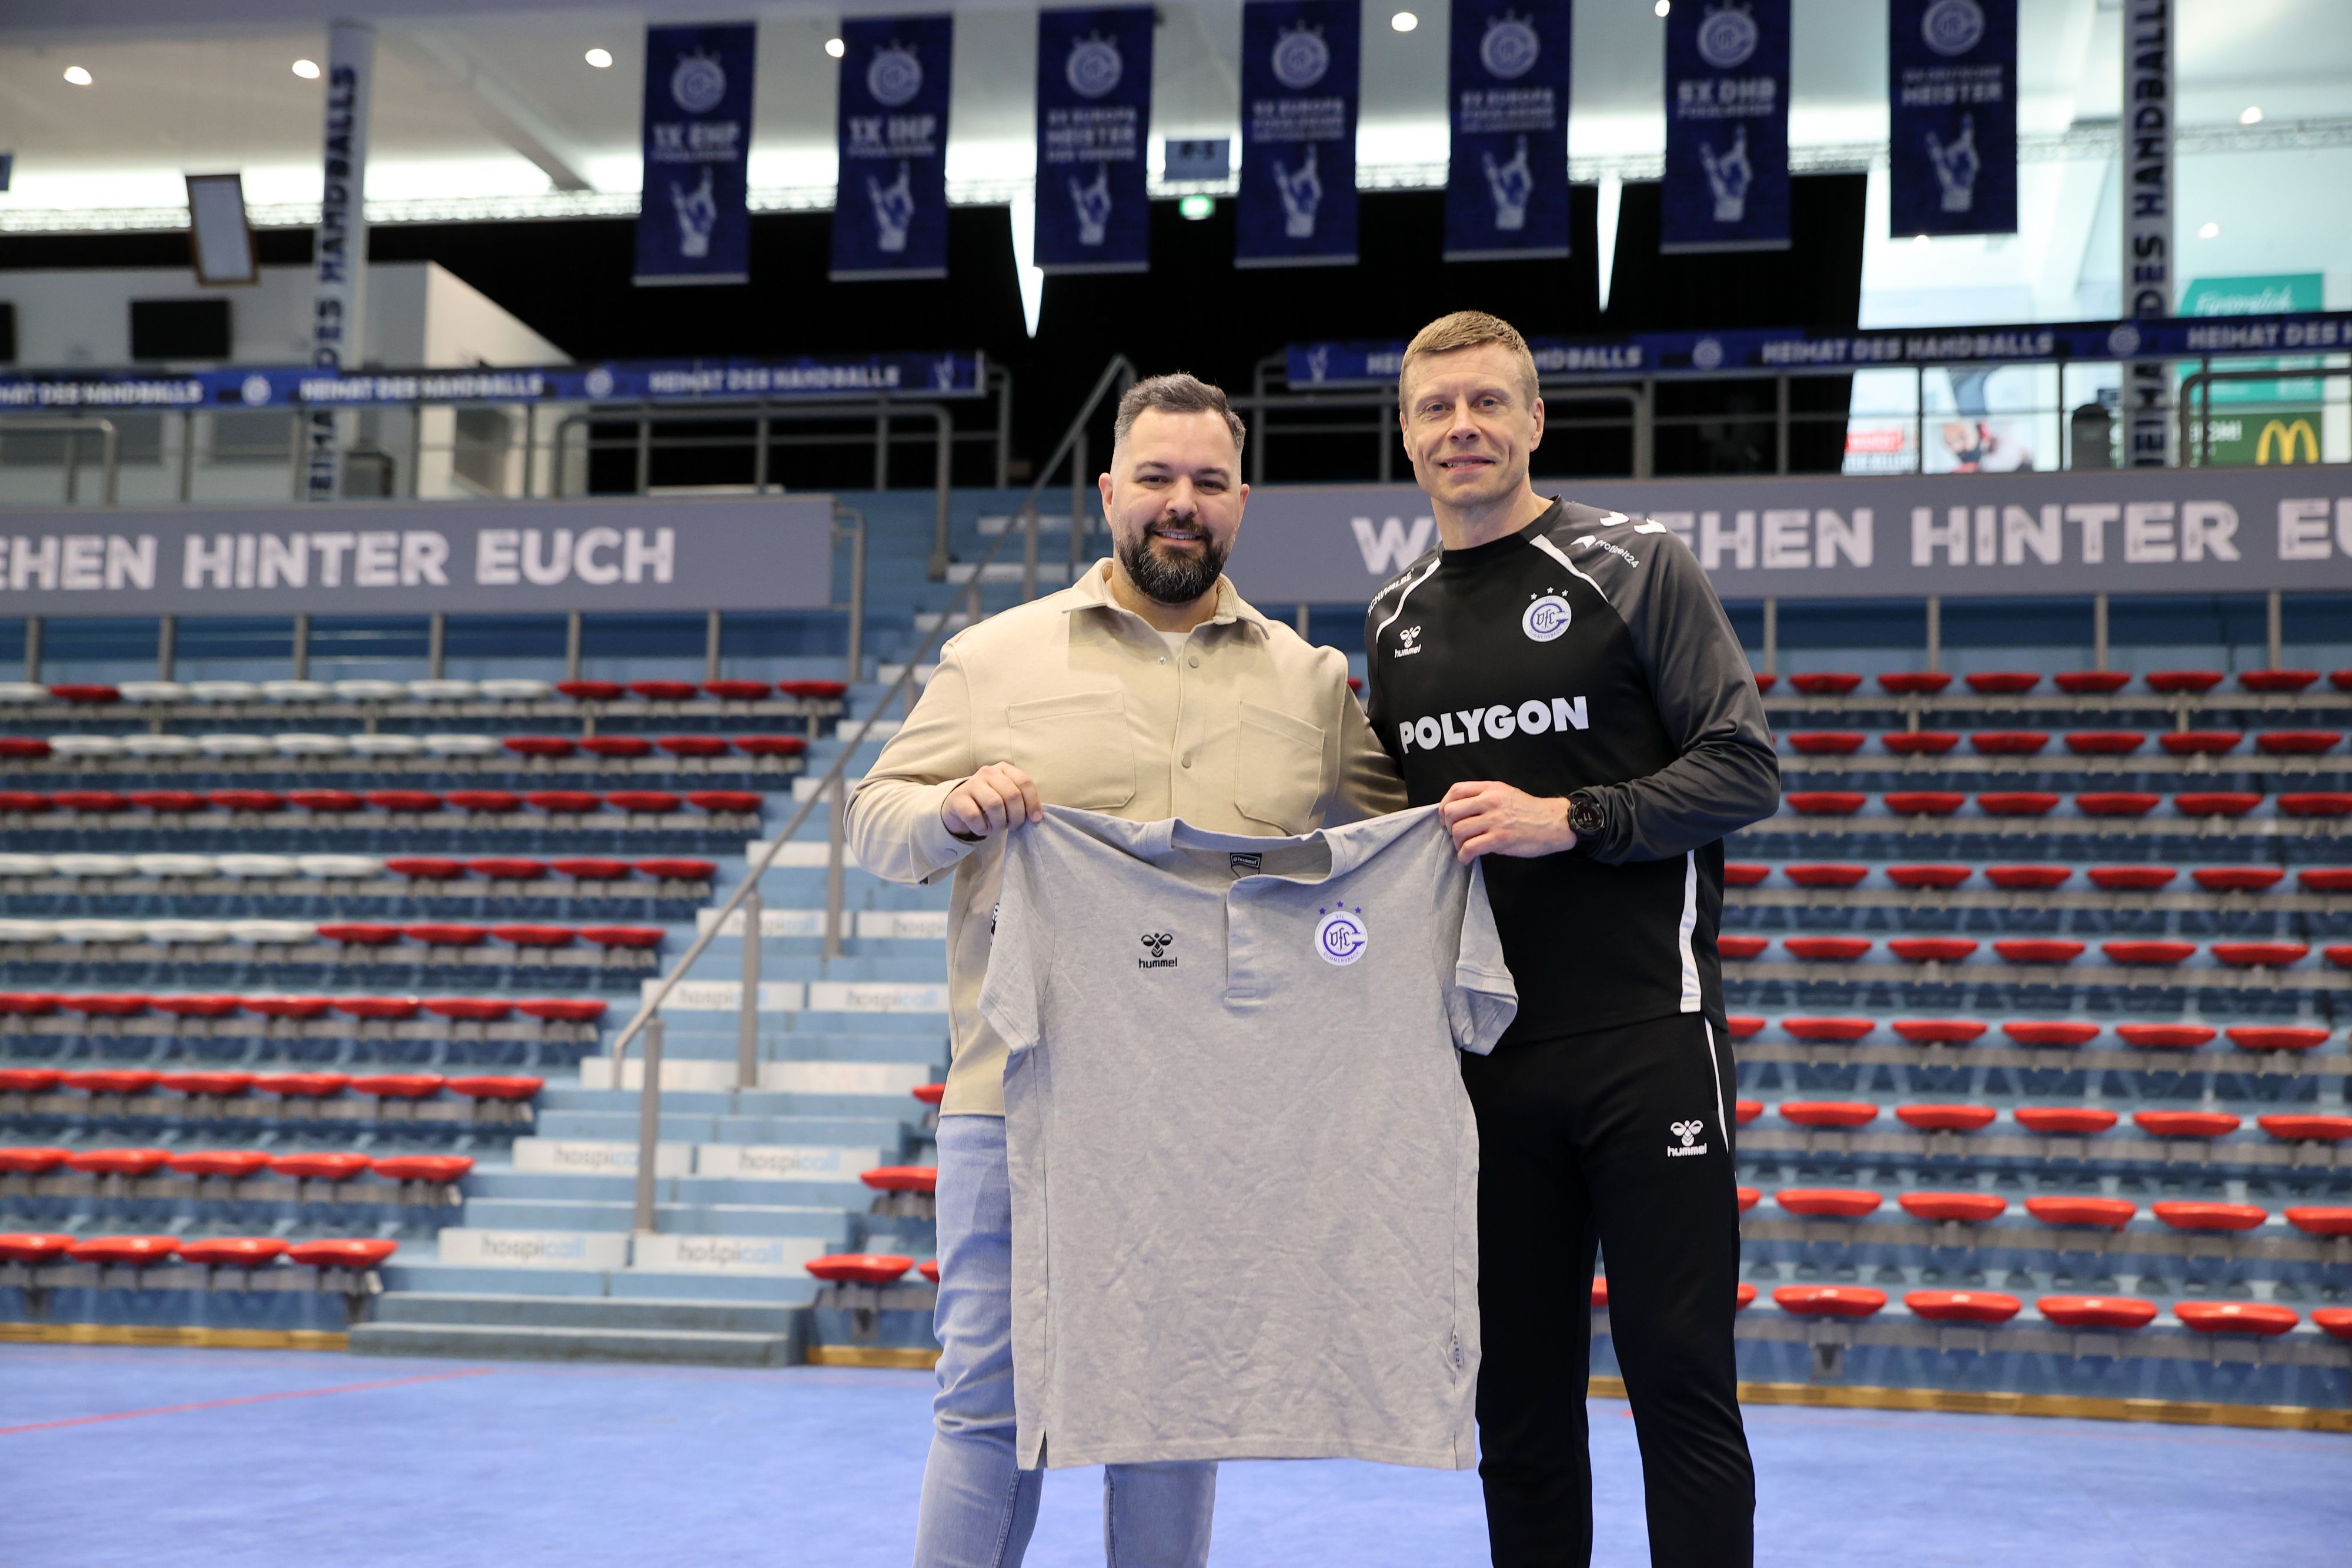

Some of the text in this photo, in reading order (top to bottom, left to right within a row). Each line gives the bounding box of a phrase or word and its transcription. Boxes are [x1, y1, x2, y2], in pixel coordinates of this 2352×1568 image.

[1762, 332, 2054, 364] HEIMAT DES HANDBALLS
[2187, 323, 2279, 349] HEIMAT
[2284, 322, 2337, 347] DES
[1911, 501, 2240, 566] HINTER
[0, 528, 676, 590] HEN HINTER EUCH
[1367, 570, 1414, 617] SCHWALBE
[1394, 643, 1422, 658] hummel
[1399, 696, 1589, 754] POLYGON
[1238, 857, 1257, 865] hummel
[1138, 957, 1178, 969] hummel
[1667, 1142, 1708, 1158] hummel
[480, 1235, 586, 1261] hospicall
[676, 1239, 784, 1266] hospicall
